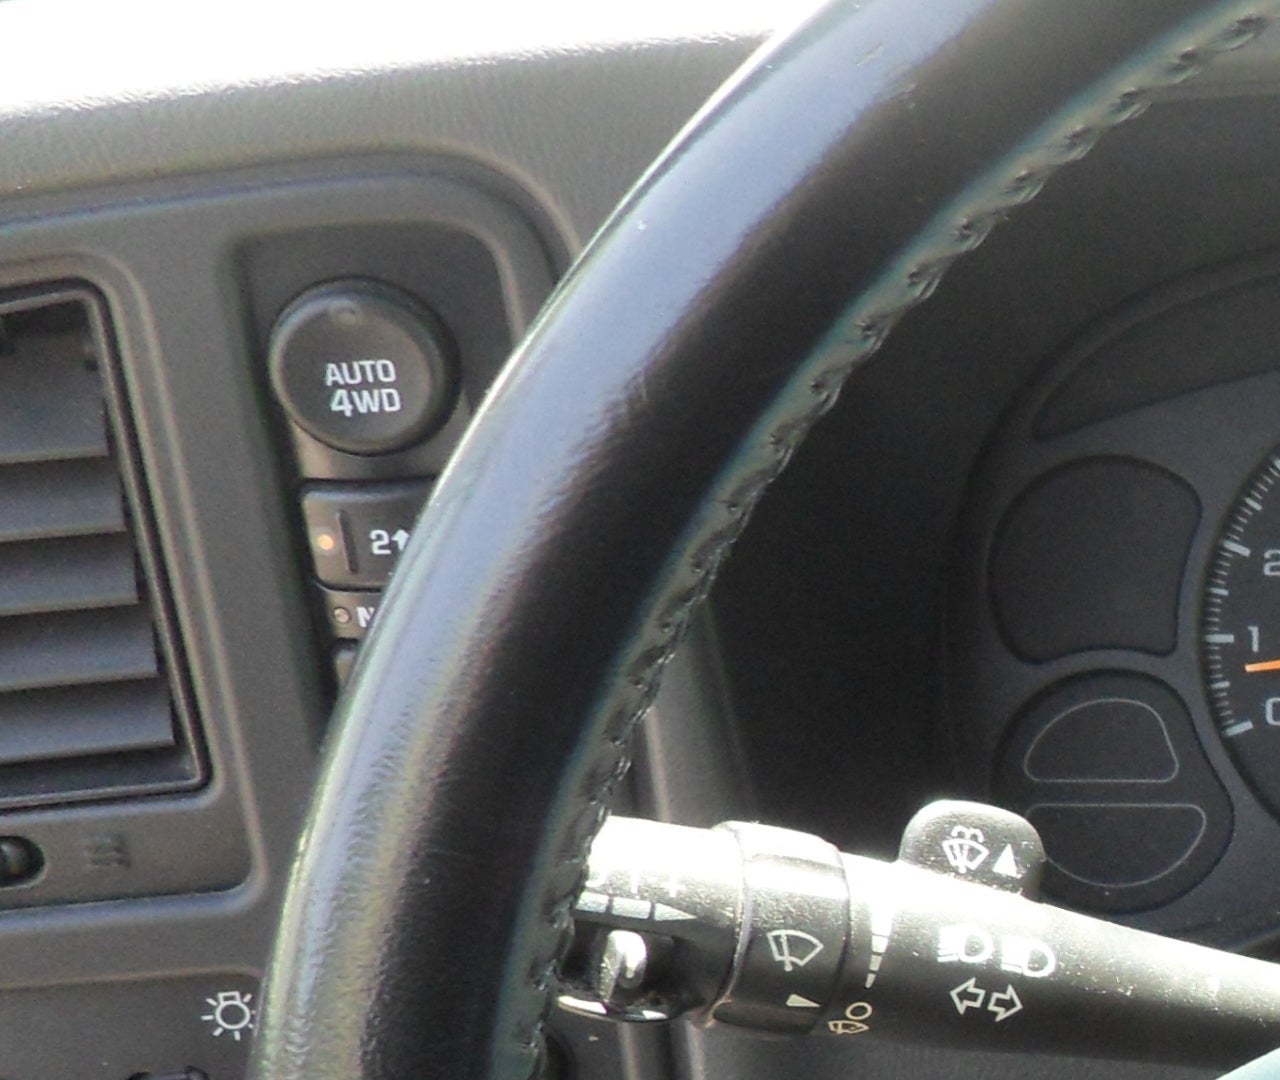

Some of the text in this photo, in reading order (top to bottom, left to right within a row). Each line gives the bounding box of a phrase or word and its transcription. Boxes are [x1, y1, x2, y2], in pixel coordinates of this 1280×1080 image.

[325, 360, 397, 387] AUTO
[330, 388, 401, 418] 4WD
[369, 529, 392, 555] 2
[1247, 626, 1260, 652] 1
